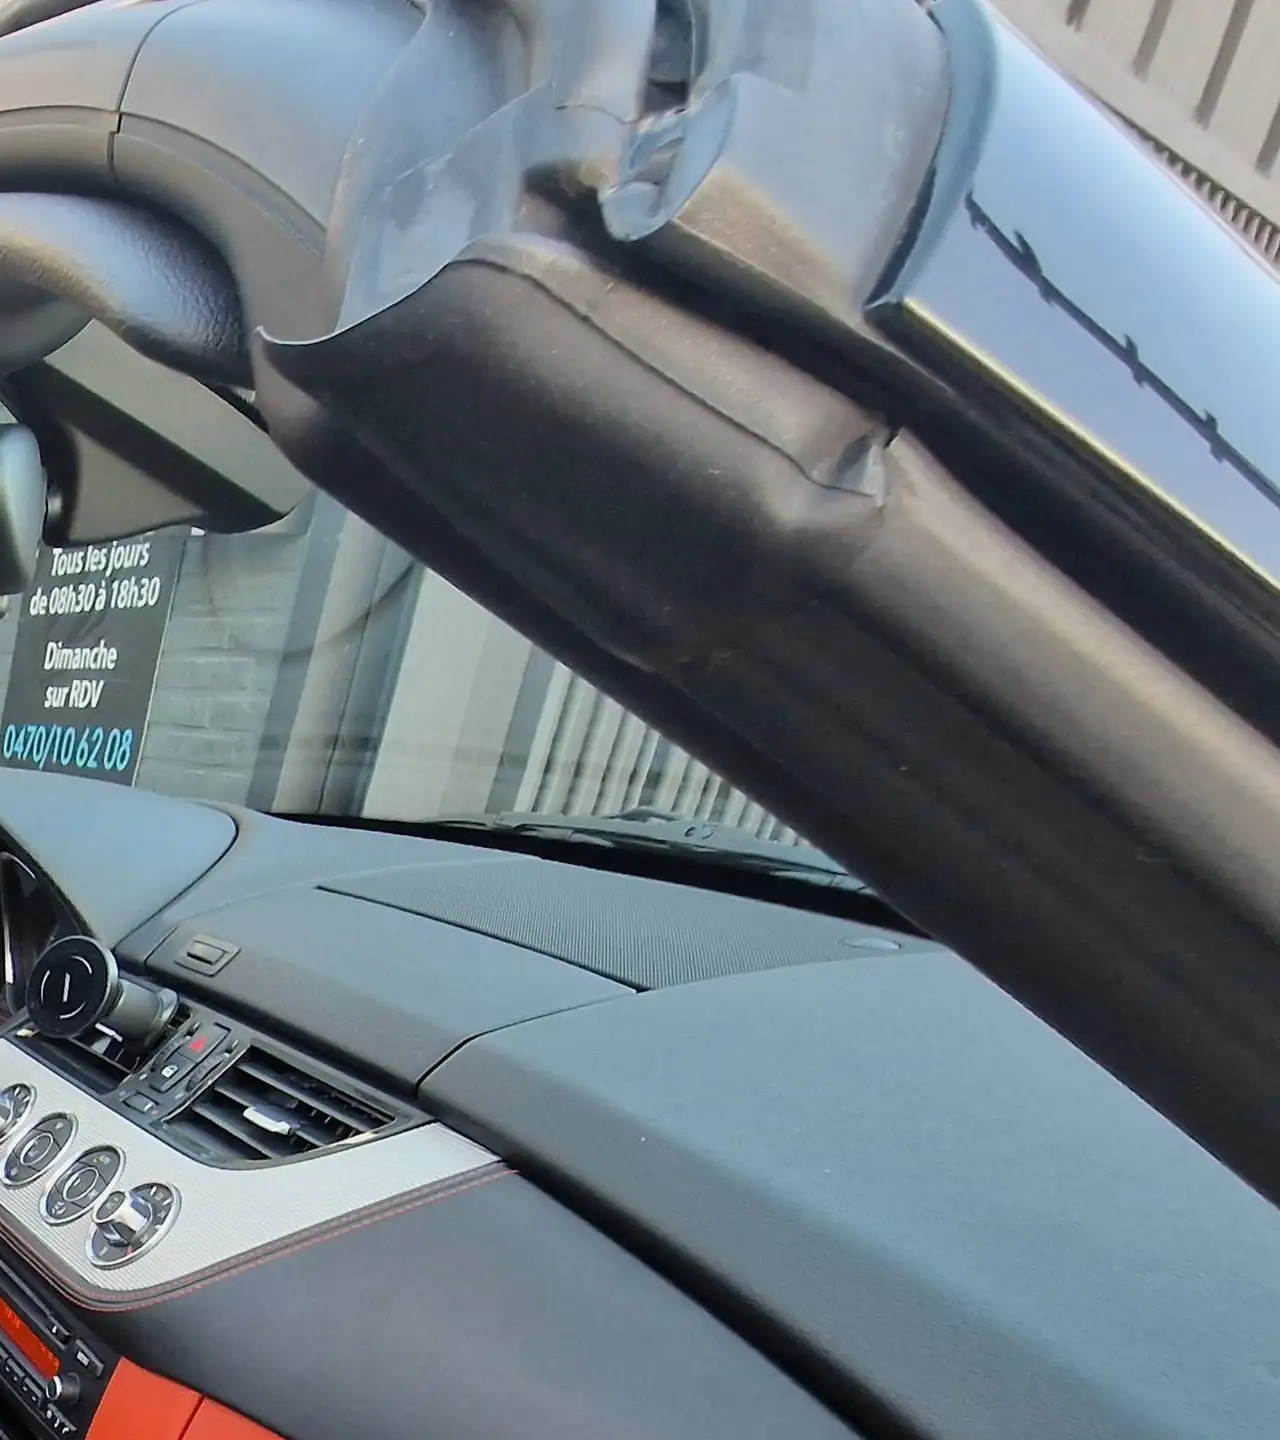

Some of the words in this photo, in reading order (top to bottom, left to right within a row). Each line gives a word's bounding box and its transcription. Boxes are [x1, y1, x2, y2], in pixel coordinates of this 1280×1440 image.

[51, 548, 85, 576] Tous
[85, 545, 107, 572] les
[106, 541, 151, 577] jours
[29, 587, 48, 615] de
[48, 584, 95, 615] 08h30
[95, 580, 107, 611] à
[110, 576, 161, 608] 18h30
[44, 639, 118, 670] Dimanche
[44, 686, 69, 708] sur
[68, 680, 105, 708] RDV
